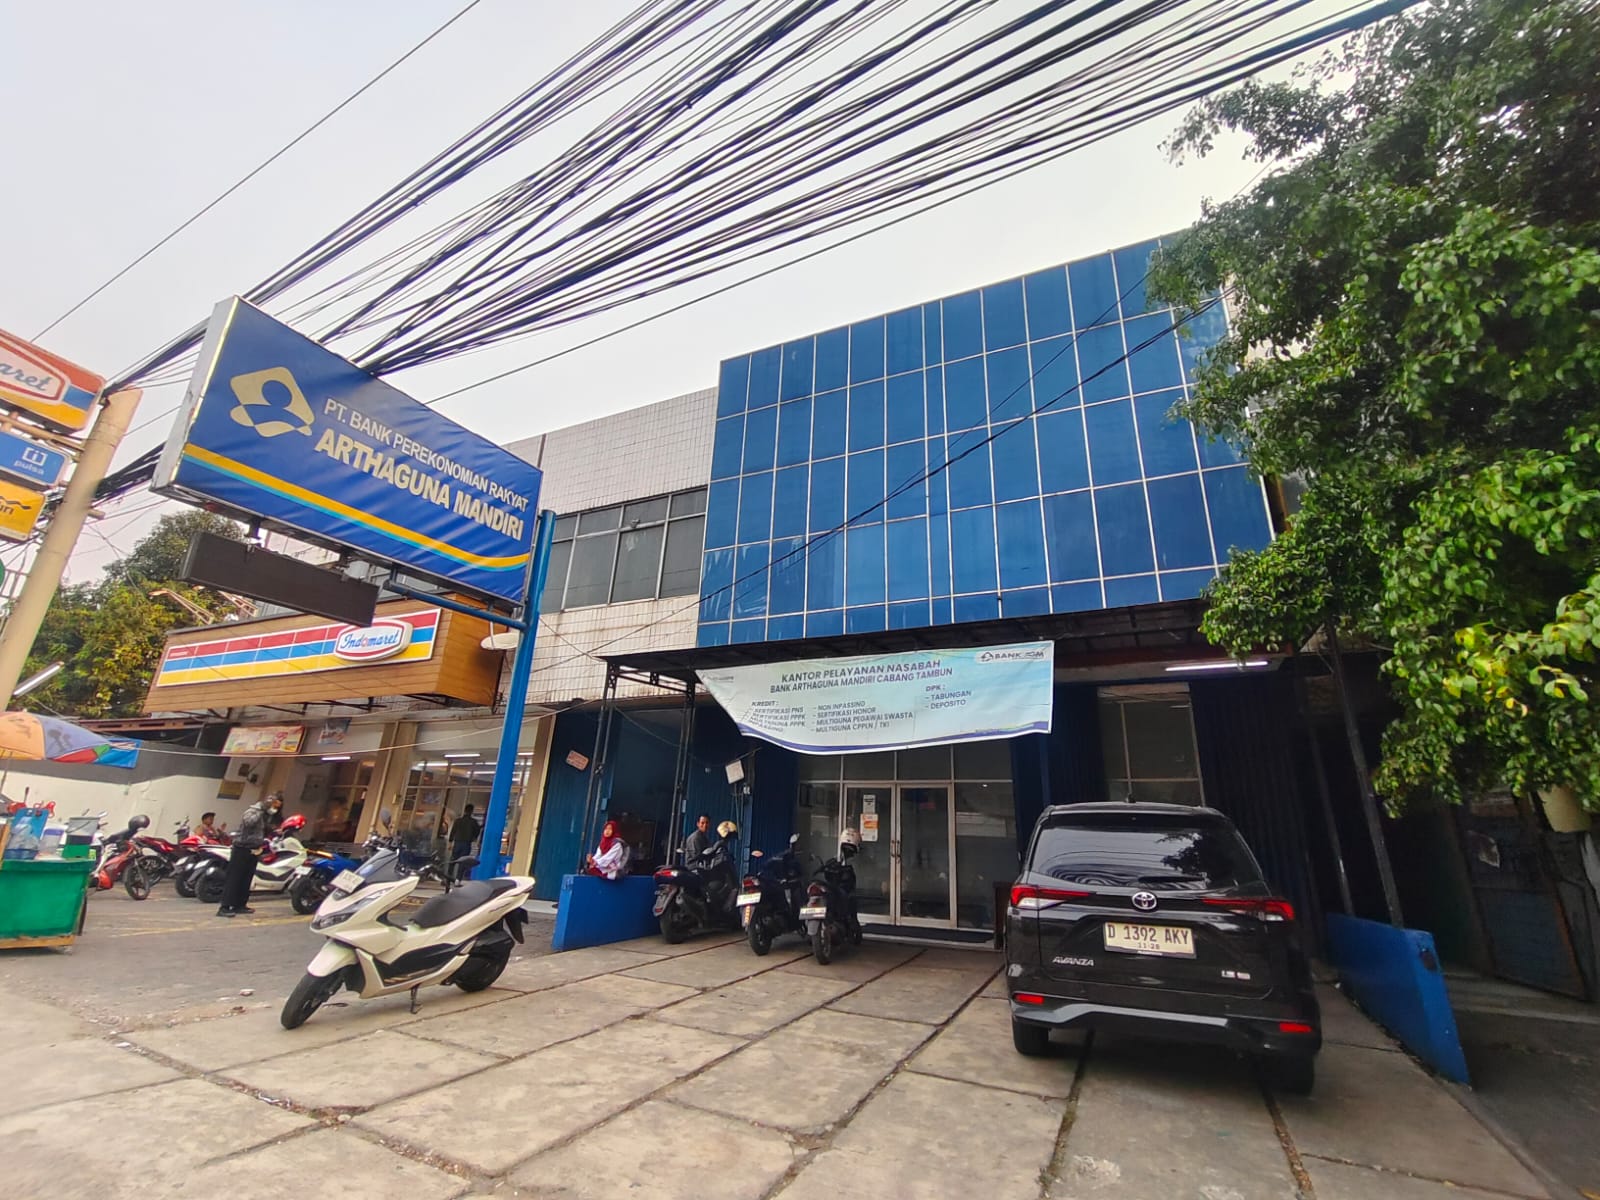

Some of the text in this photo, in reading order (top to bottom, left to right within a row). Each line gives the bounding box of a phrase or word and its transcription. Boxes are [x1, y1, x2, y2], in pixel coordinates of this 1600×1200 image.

[324, 398, 529, 512] PT. BANK PEREKONOMIAN RAKYAT
[14, 460, 45, 475] pulsa
[314, 428, 524, 541] ARTHAGUNA MANDIRI
[340, 629, 400, 649] Indomaret
[782, 660, 941, 683] KANTOR PELAYANAN NASABAH
[770, 668, 953, 693] BANK ARTHAGUNA MANDIRI CABANG TAMBUN
[931, 691, 972, 701] TABUNGAN
[931, 700, 966, 709] DEPOSITO
[817, 709, 851, 718] SERTIFIKASI
[853, 707, 876, 716] HONOR
[817, 717, 851, 726] MULTIGUNA
[853, 713, 882, 723] PEGAWAI
[884, 711, 914, 720] SWASTA
[816, 724, 851, 732] MULTIGUNA
[1108, 924, 1189, 944] D 1392 AKY
[1052, 956, 1094, 967] AVANZA
